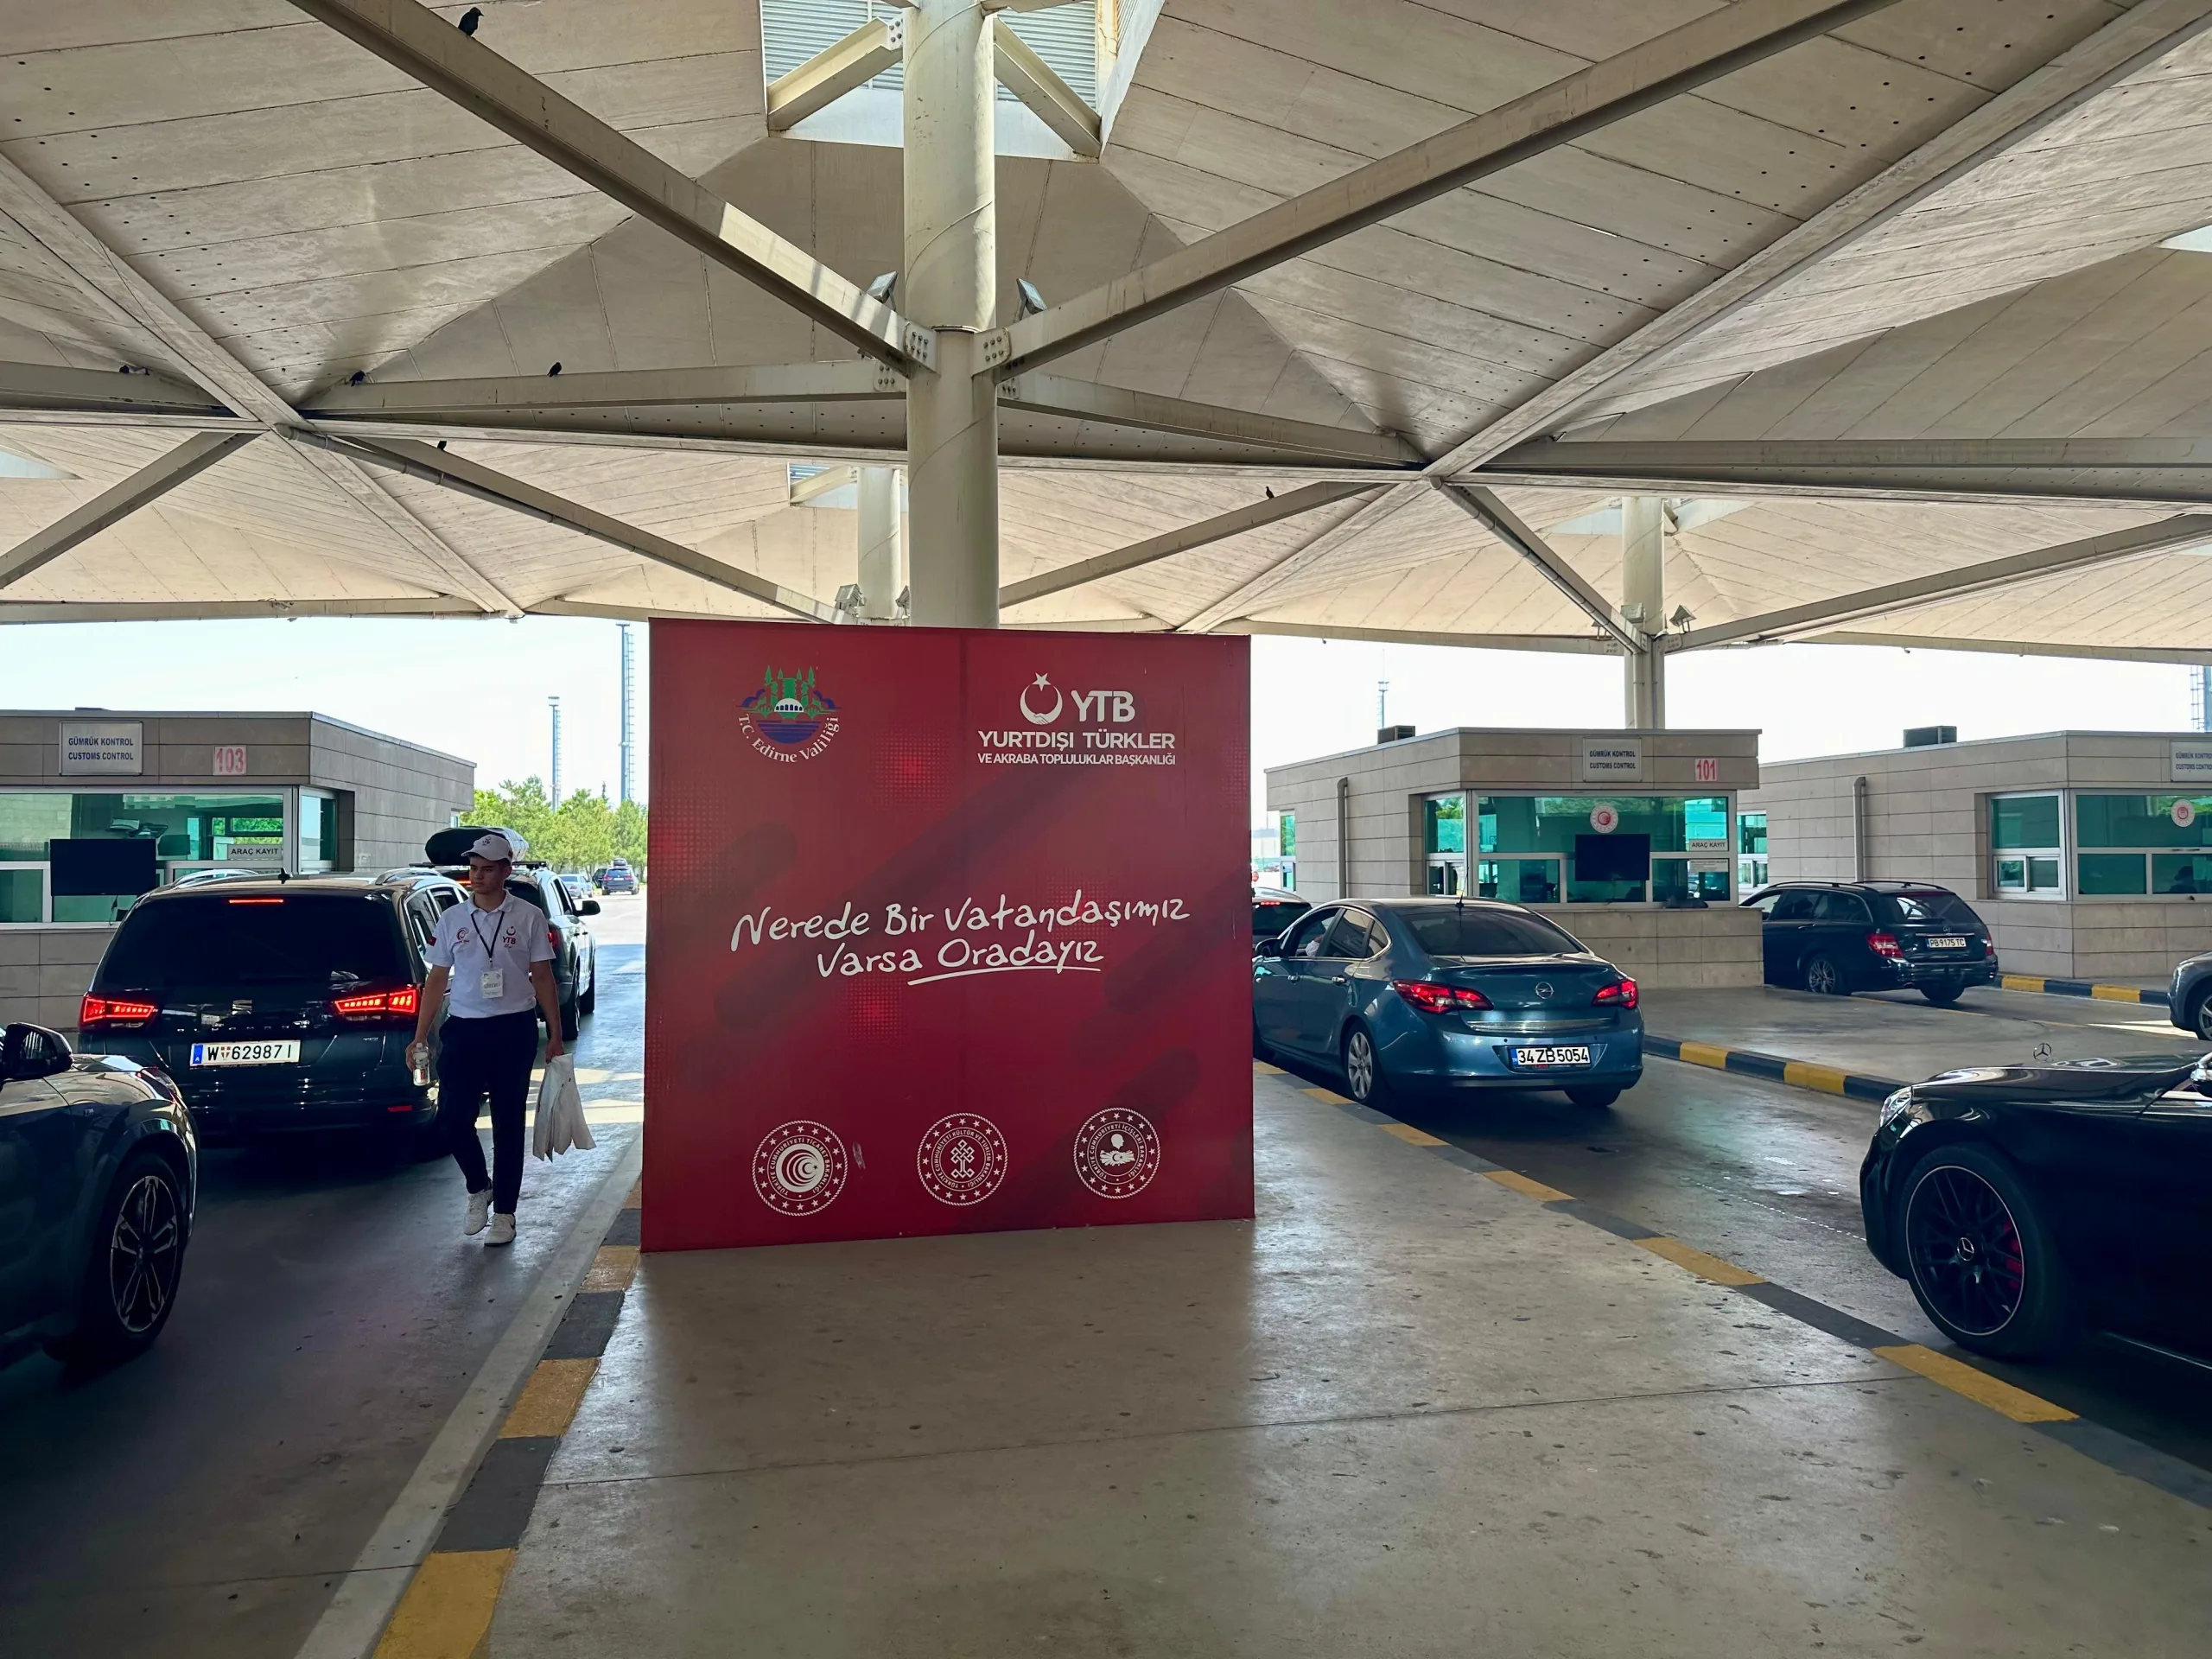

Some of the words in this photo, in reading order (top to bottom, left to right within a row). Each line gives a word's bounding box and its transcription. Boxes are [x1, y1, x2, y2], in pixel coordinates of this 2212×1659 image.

[1071, 690, 1135, 722] YTB
[68, 737, 99, 746] GÜMRÜK
[738, 714, 754, 739] T.C.
[752, 738, 797, 762] Edirne
[798, 717, 839, 760] Valiliği
[978, 731, 1073, 752] YURTDIŞI
[1083, 728, 1175, 749] TÜRKLER
[68, 752, 100, 760] CUSTOMS
[102, 752, 134, 760] CONTROL
[216, 747, 245, 773] 103
[977, 753, 993, 764] VE
[994, 753, 1038, 764] AKRABA
[1039, 753, 1114, 765] TOPLULUKLAR
[1115, 753, 1175, 766] BAŞKANLIĞI
[1589, 749, 1611, 758] GÜMRÜK
[1697, 760, 1716, 780] 101
[731, 901, 869, 952] Nerede
[885, 903, 934, 936] Bir
[945, 889, 1190, 933] Vatandaşımız
[817, 943, 923, 977] Varsa
[938, 929, 1104, 974] Oradayız
[207, 1046, 219, 1061] W
[232, 1045, 283, 1059] 62987
[1517, 1050, 1535, 1063] 34
[1535, 1049, 1555, 1063] ZB
[1556, 1048, 1588, 1062] 5054
[806, 1138, 829, 1158] TİCARET
